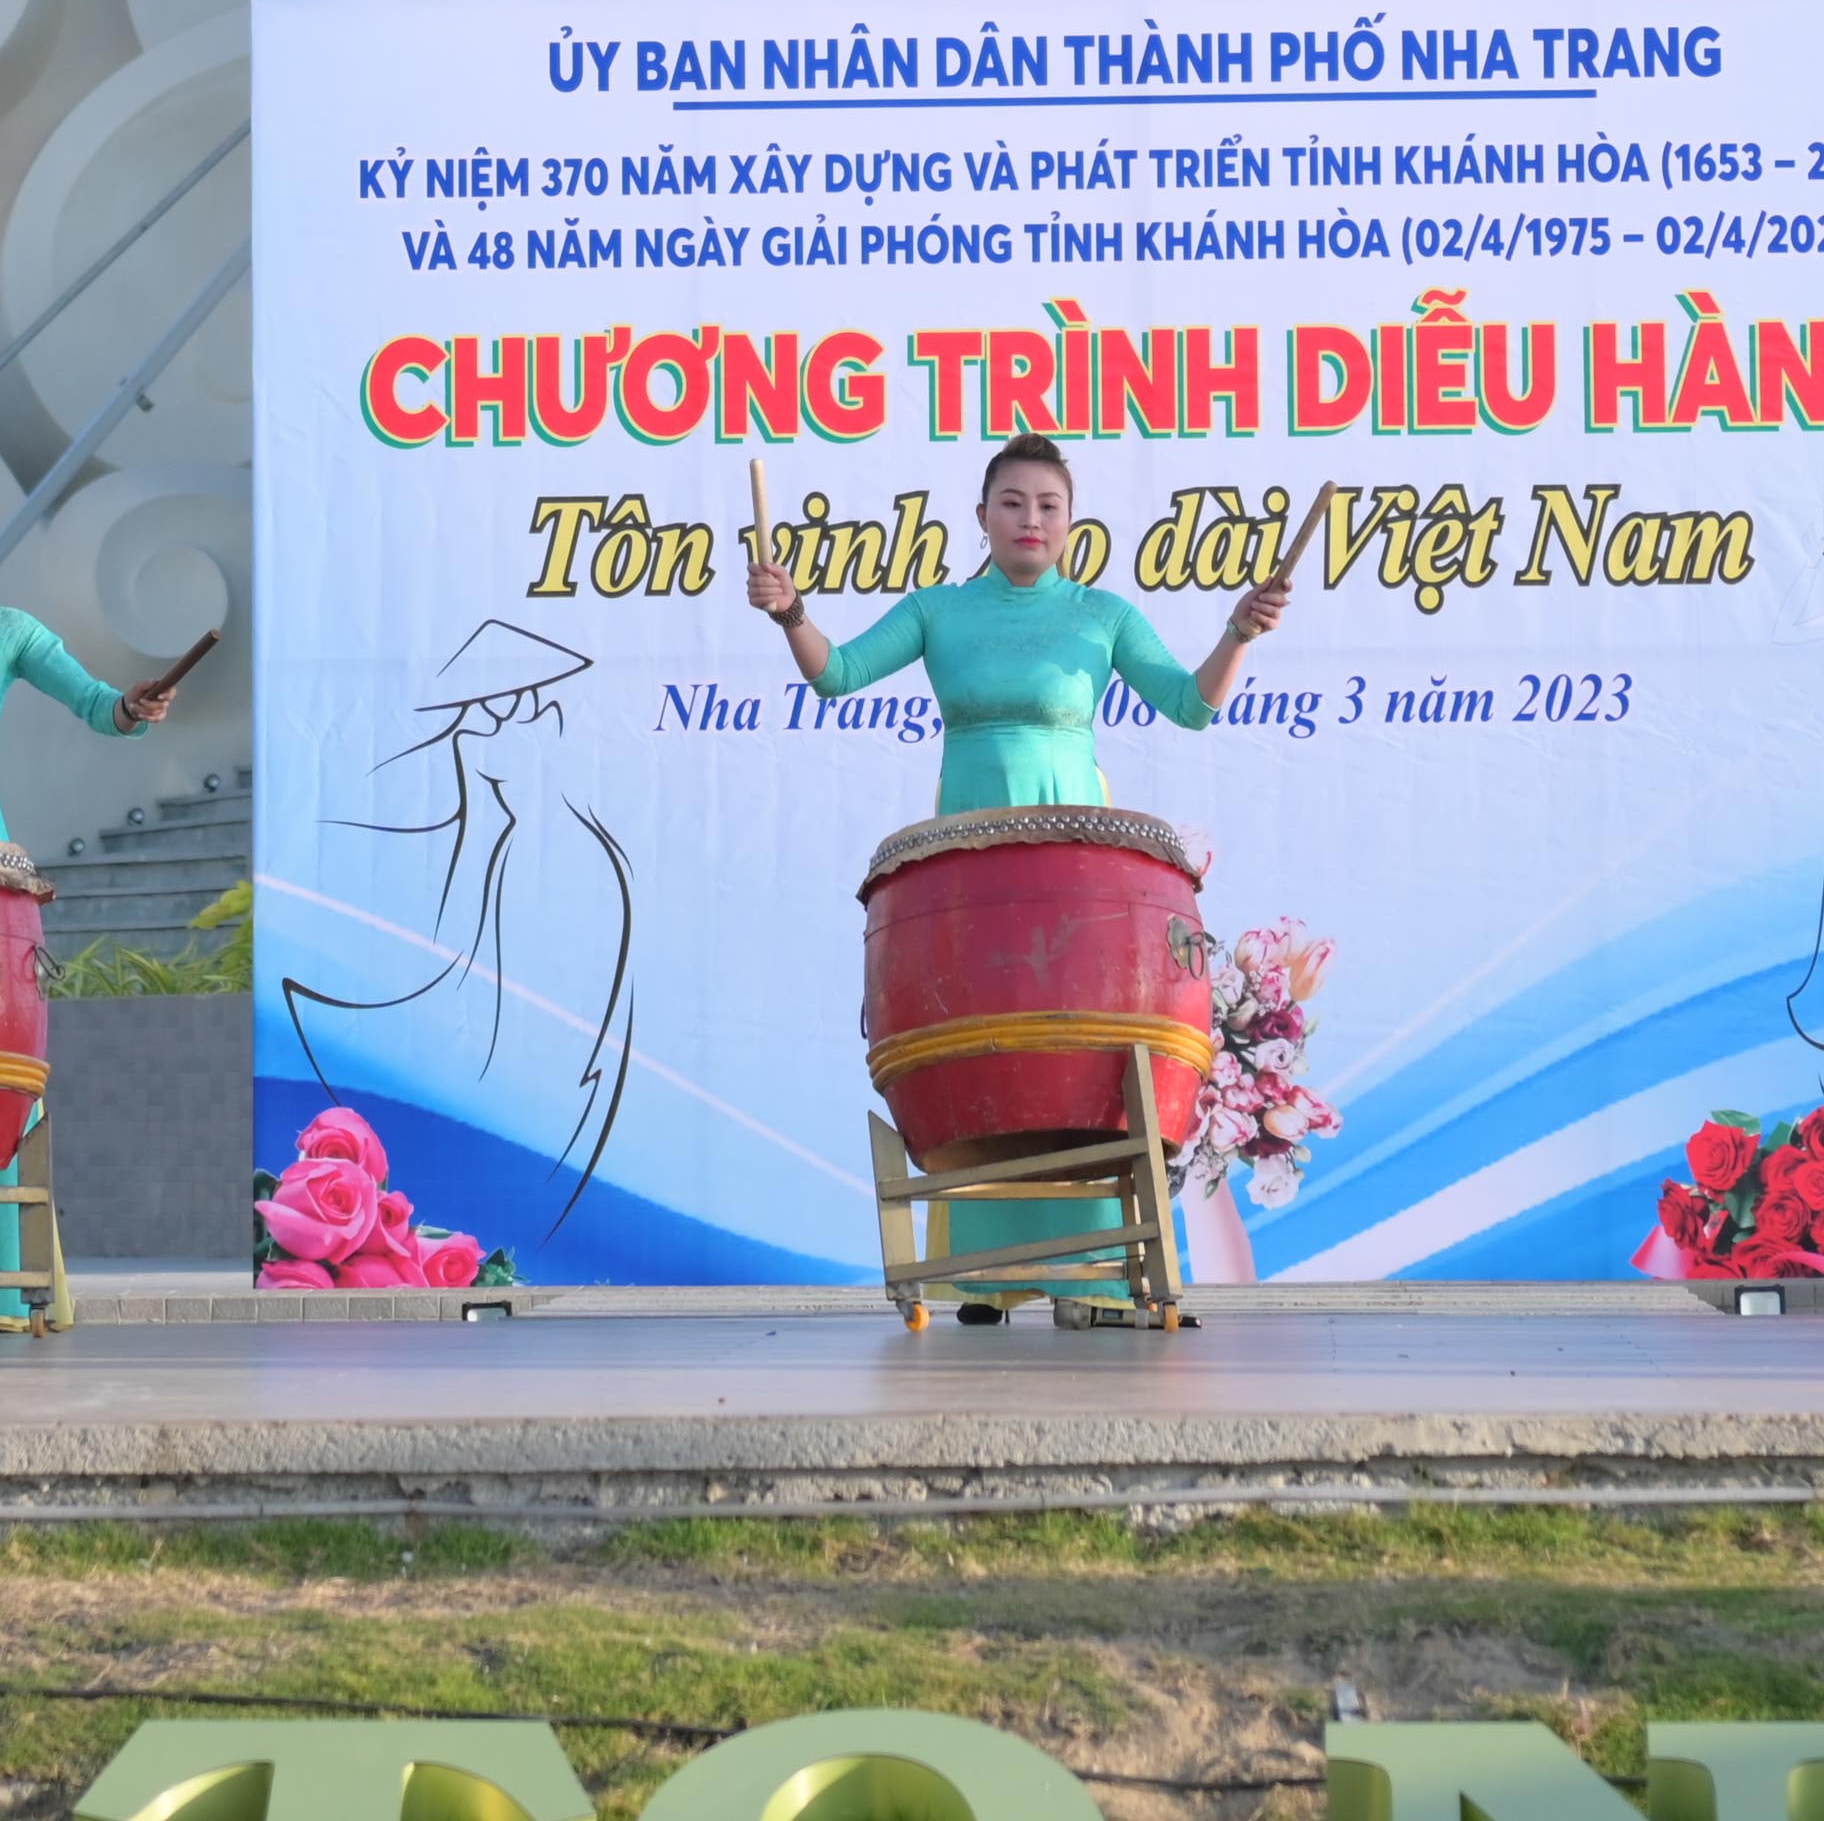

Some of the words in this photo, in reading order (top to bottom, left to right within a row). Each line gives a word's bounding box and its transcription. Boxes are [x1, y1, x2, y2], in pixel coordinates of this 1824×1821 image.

[548, 24, 622, 94] ỦY
[636, 38, 747, 93] BAN
[762, 21, 920, 91] NHÂN
[935, 20, 1049, 89] DÂN
[1062, 18, 1254, 87] THÀNH
[1269, 11, 1386, 84] PHỐ
[1401, 27, 1521, 82] NHA
[1532, 24, 1723, 80] TRANG
[358, 146, 415, 200] KỶ
[426, 146, 530, 212] NIỆM
[542, 156, 610, 198] 370
[621, 143, 718, 197] NĂM
[728, 142, 813, 196] XÂY
[824, 148, 954, 207] DỰNG
[963, 138, 1020, 193] VÀ
[1030, 137, 1139, 192] PHÁT
[1148, 132, 1271, 190] TRIỂN
[1281, 134, 1383, 188] TỈNH
[1394, 131, 1545, 186] KHÁNH
[1557, 130, 1651, 184] HÒA
[1661, 140, 1764, 191] (1653
[401, 218, 459, 272] VÀ
[466, 230, 516, 271] 48
[526, 216, 623, 271] NĂM
[634, 215, 751, 269] NGÀY
[761, 213, 849, 268] GIẢI
[860, 212, 1014, 266] PHÓNG
[1023, 210, 1124, 264] TỈNH
[1135, 208, 1286, 262] KHÁNH
[1297, 206, 1392, 260] HÒA
[1401, 213, 1612, 266] (02/4/1975
[360, 324, 886, 447] CHƯƠNG
[909, 296, 1260, 441] TRÌNH
[1287, 288, 1557, 436] DIỄU
[527, 493, 714, 598] Tôn
[1134, 486, 1292, 592] dài
[1306, 483, 1506, 616] Việt
[1512, 484, 1756, 588] Nam
[654, 682, 762, 733] Nha
[784, 681, 946, 745] Trang,
[1101, 678, 1159, 729] 08
[1337, 674, 1368, 726] 3
[1383, 677, 1495, 725] năm
[1512, 671, 1634, 723] 2023
